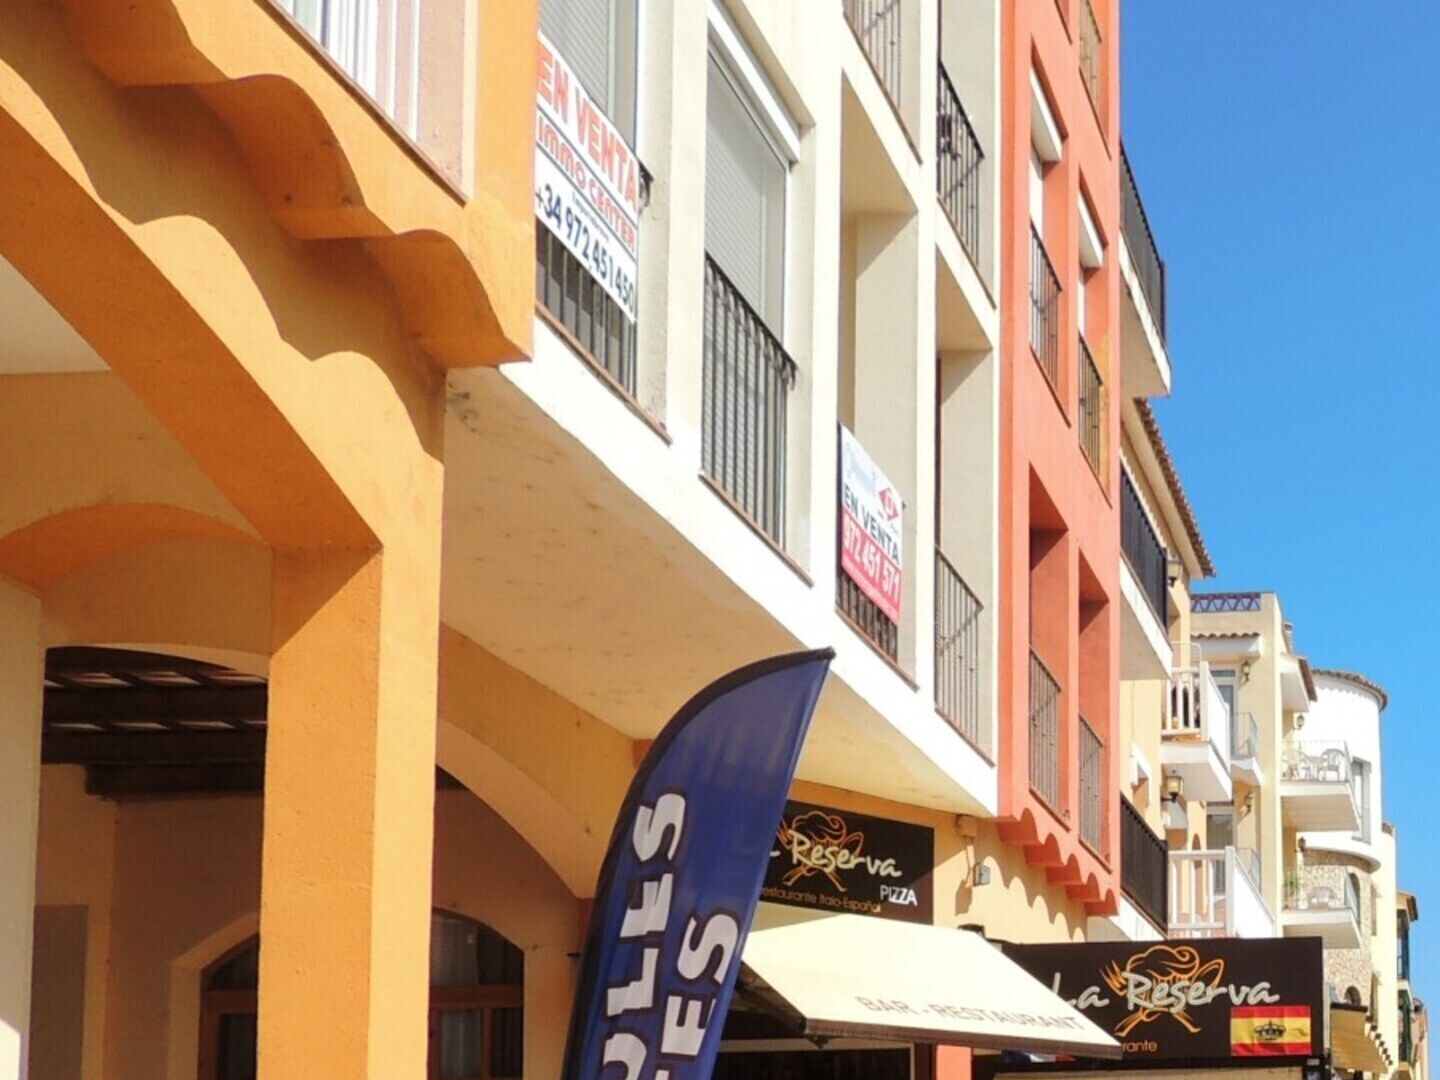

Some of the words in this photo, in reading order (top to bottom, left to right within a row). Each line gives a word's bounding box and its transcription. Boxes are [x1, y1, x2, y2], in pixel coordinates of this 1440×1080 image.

[537, 44, 569, 124] EN
[575, 85, 638, 213] VENTA
[565, 206, 590, 260] 972
[592, 241, 614, 289] 451
[844, 486, 859, 520] EN
[862, 506, 900, 566] VENTA
[788, 829, 902, 877] Reserva
[762, 887, 818, 903] estaurante
[880, 885, 918, 906] PIZZA
[856, 996, 911, 1015] BAR
[930, 1004, 1084, 1031] RESTAURANT
[1122, 971, 1280, 1014] Reserva
